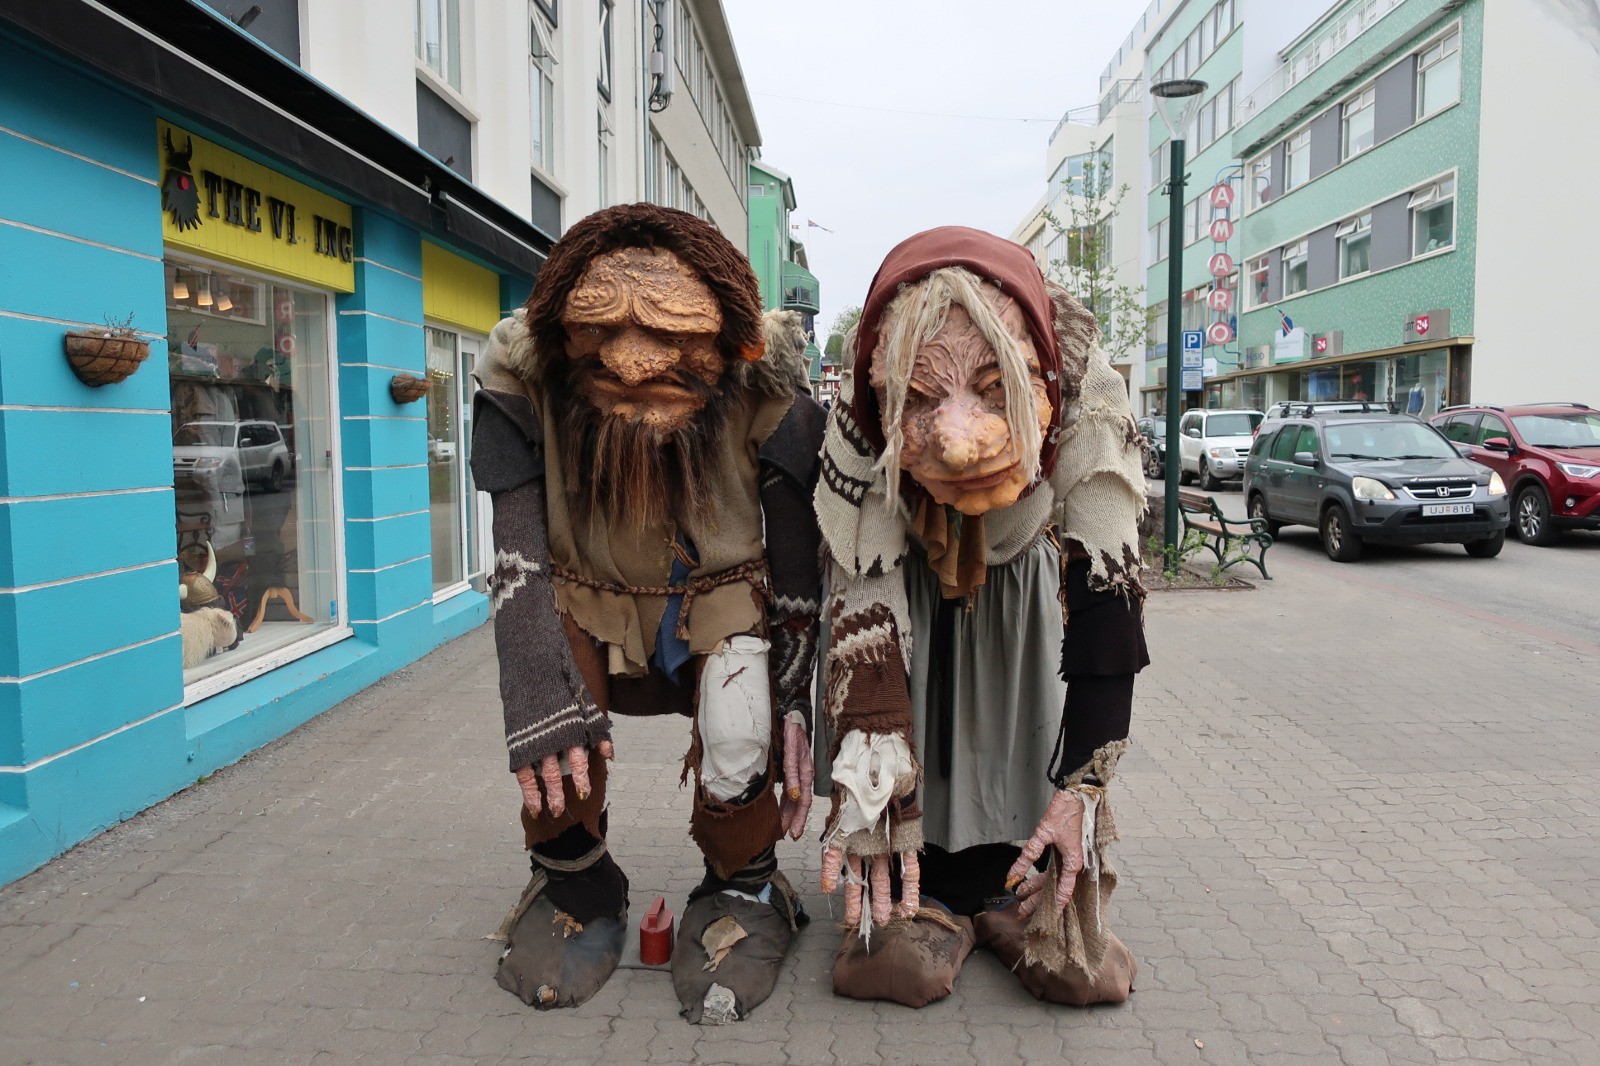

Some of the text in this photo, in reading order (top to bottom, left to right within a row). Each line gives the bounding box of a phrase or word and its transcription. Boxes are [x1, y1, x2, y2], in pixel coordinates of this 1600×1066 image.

[203, 170, 262, 232] THE
[1211, 187, 1230, 342] AMARO
[1417, 318, 1428, 330] 24
[1187, 334, 1198, 348] P
[1317, 340, 1326, 350] 24
[1453, 504, 1471, 513] 816
